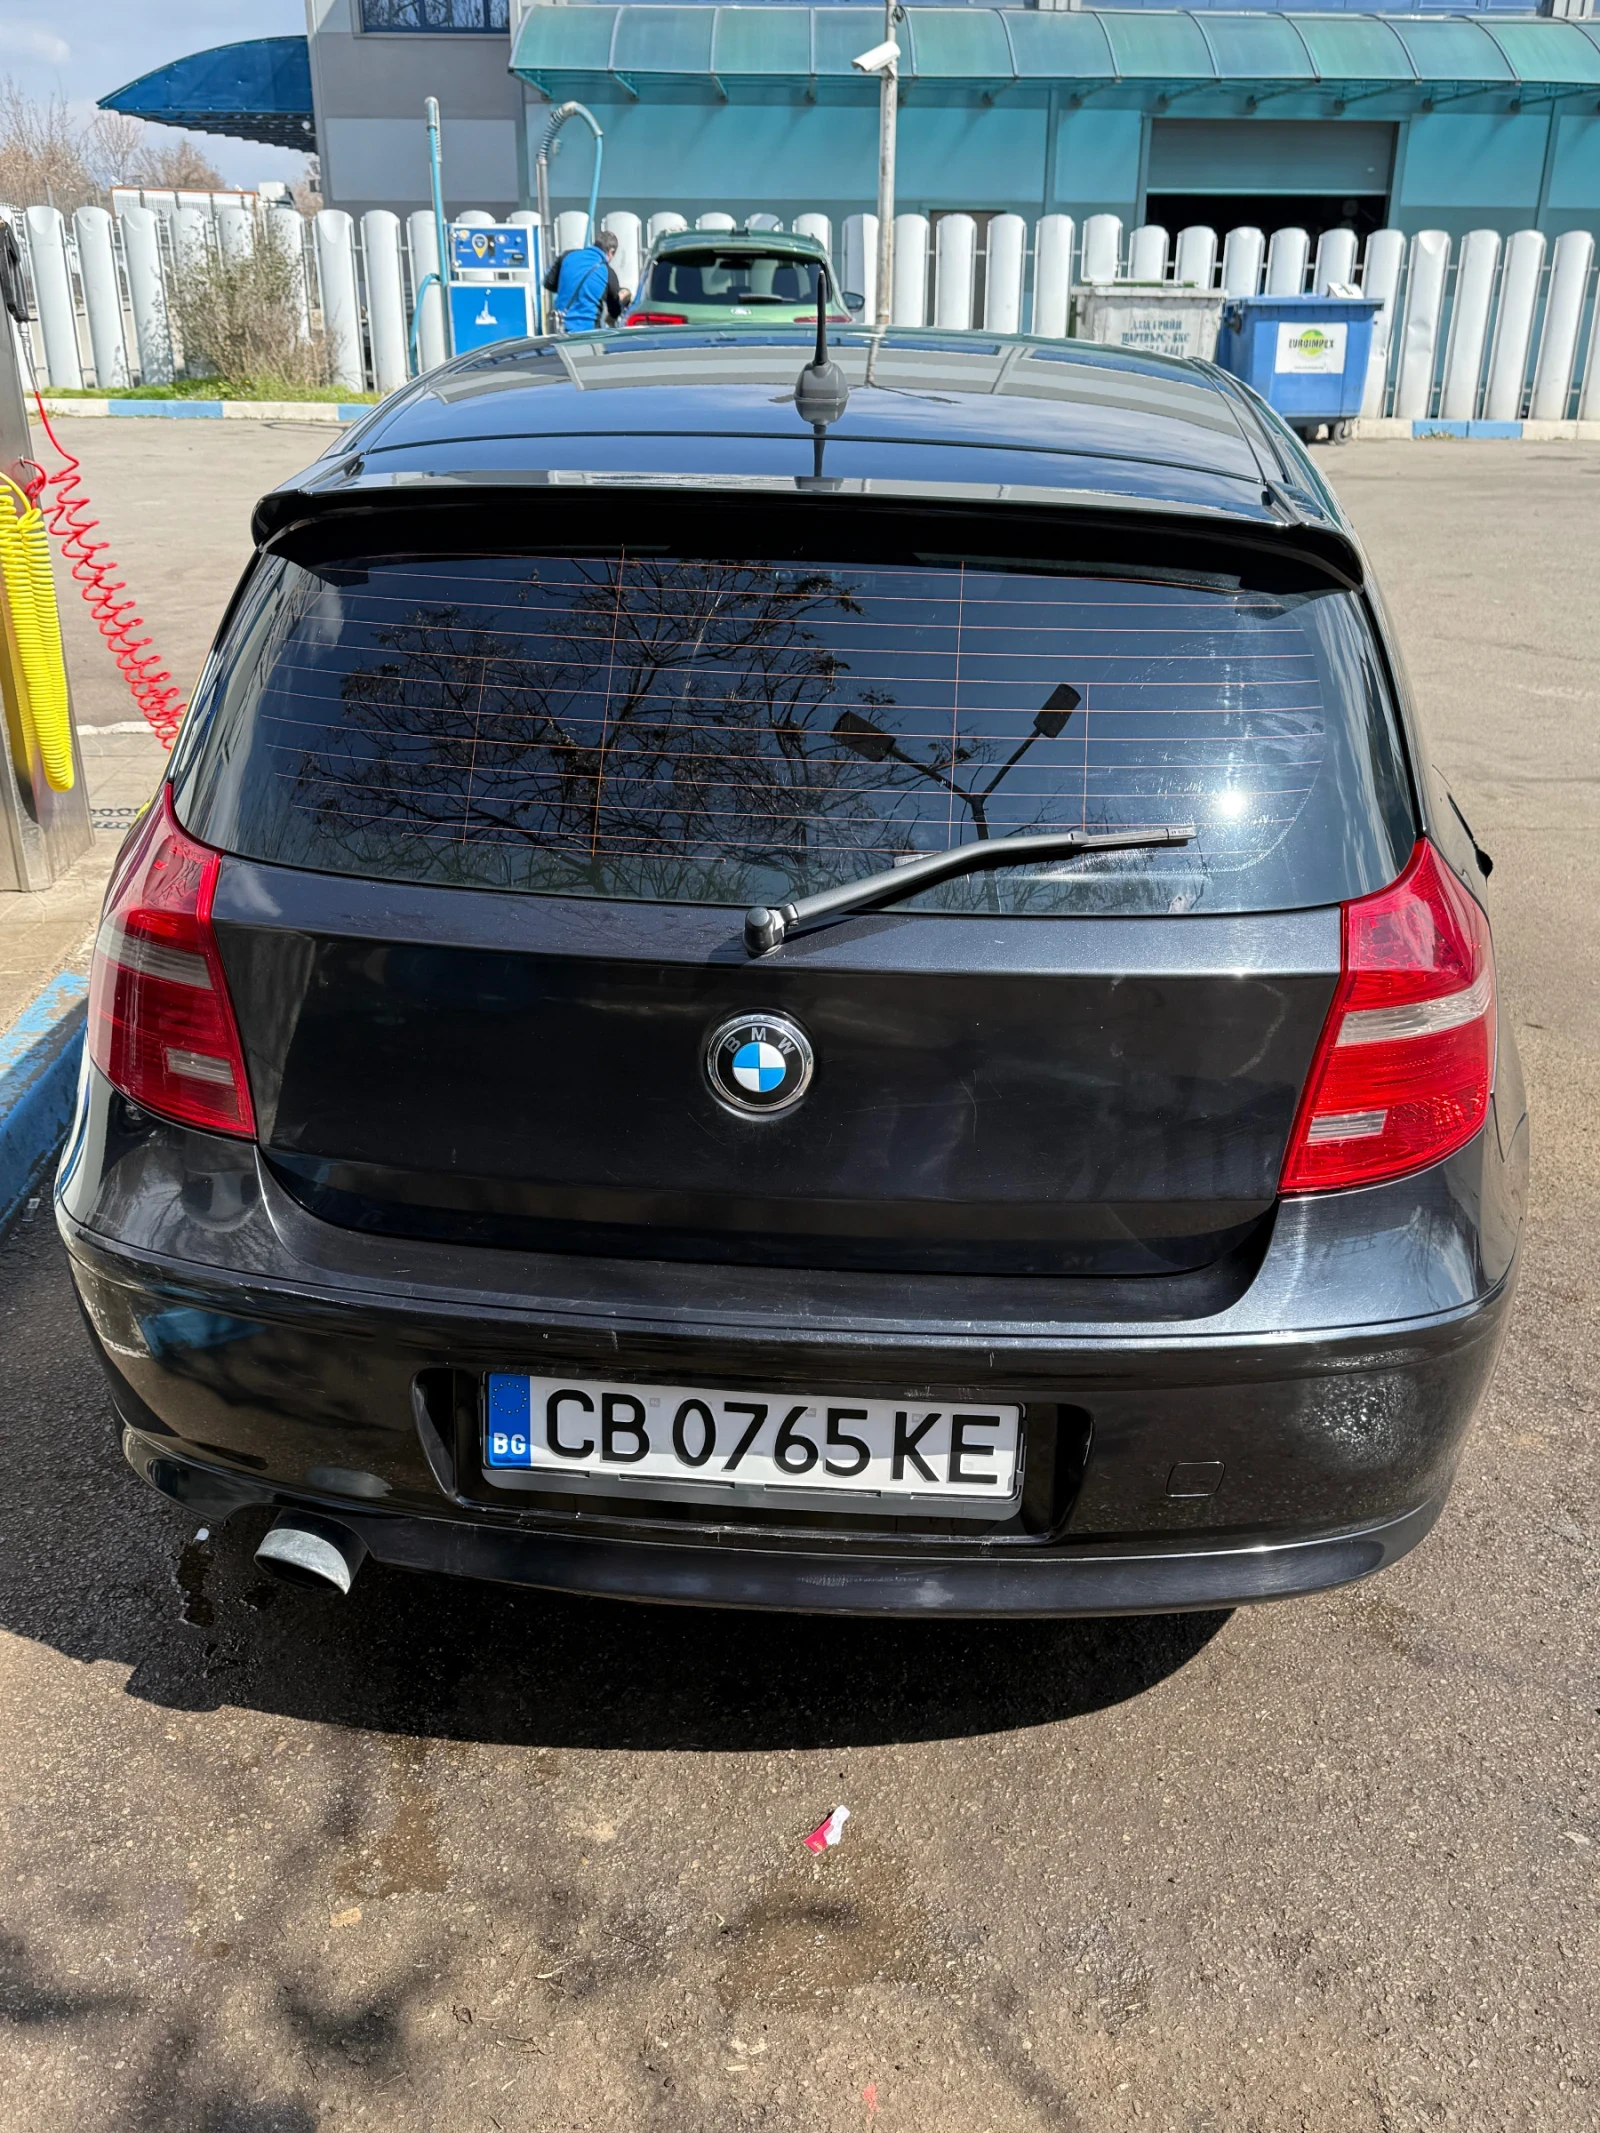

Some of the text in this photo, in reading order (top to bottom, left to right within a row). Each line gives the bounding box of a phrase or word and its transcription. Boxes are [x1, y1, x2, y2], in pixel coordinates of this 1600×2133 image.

[1288, 338, 1335, 349] EUROIMPEX
[724, 1027, 796, 1055] BMW
[493, 1432, 526, 1455] BG
[546, 1389, 1000, 1483] CB 0765 KE
